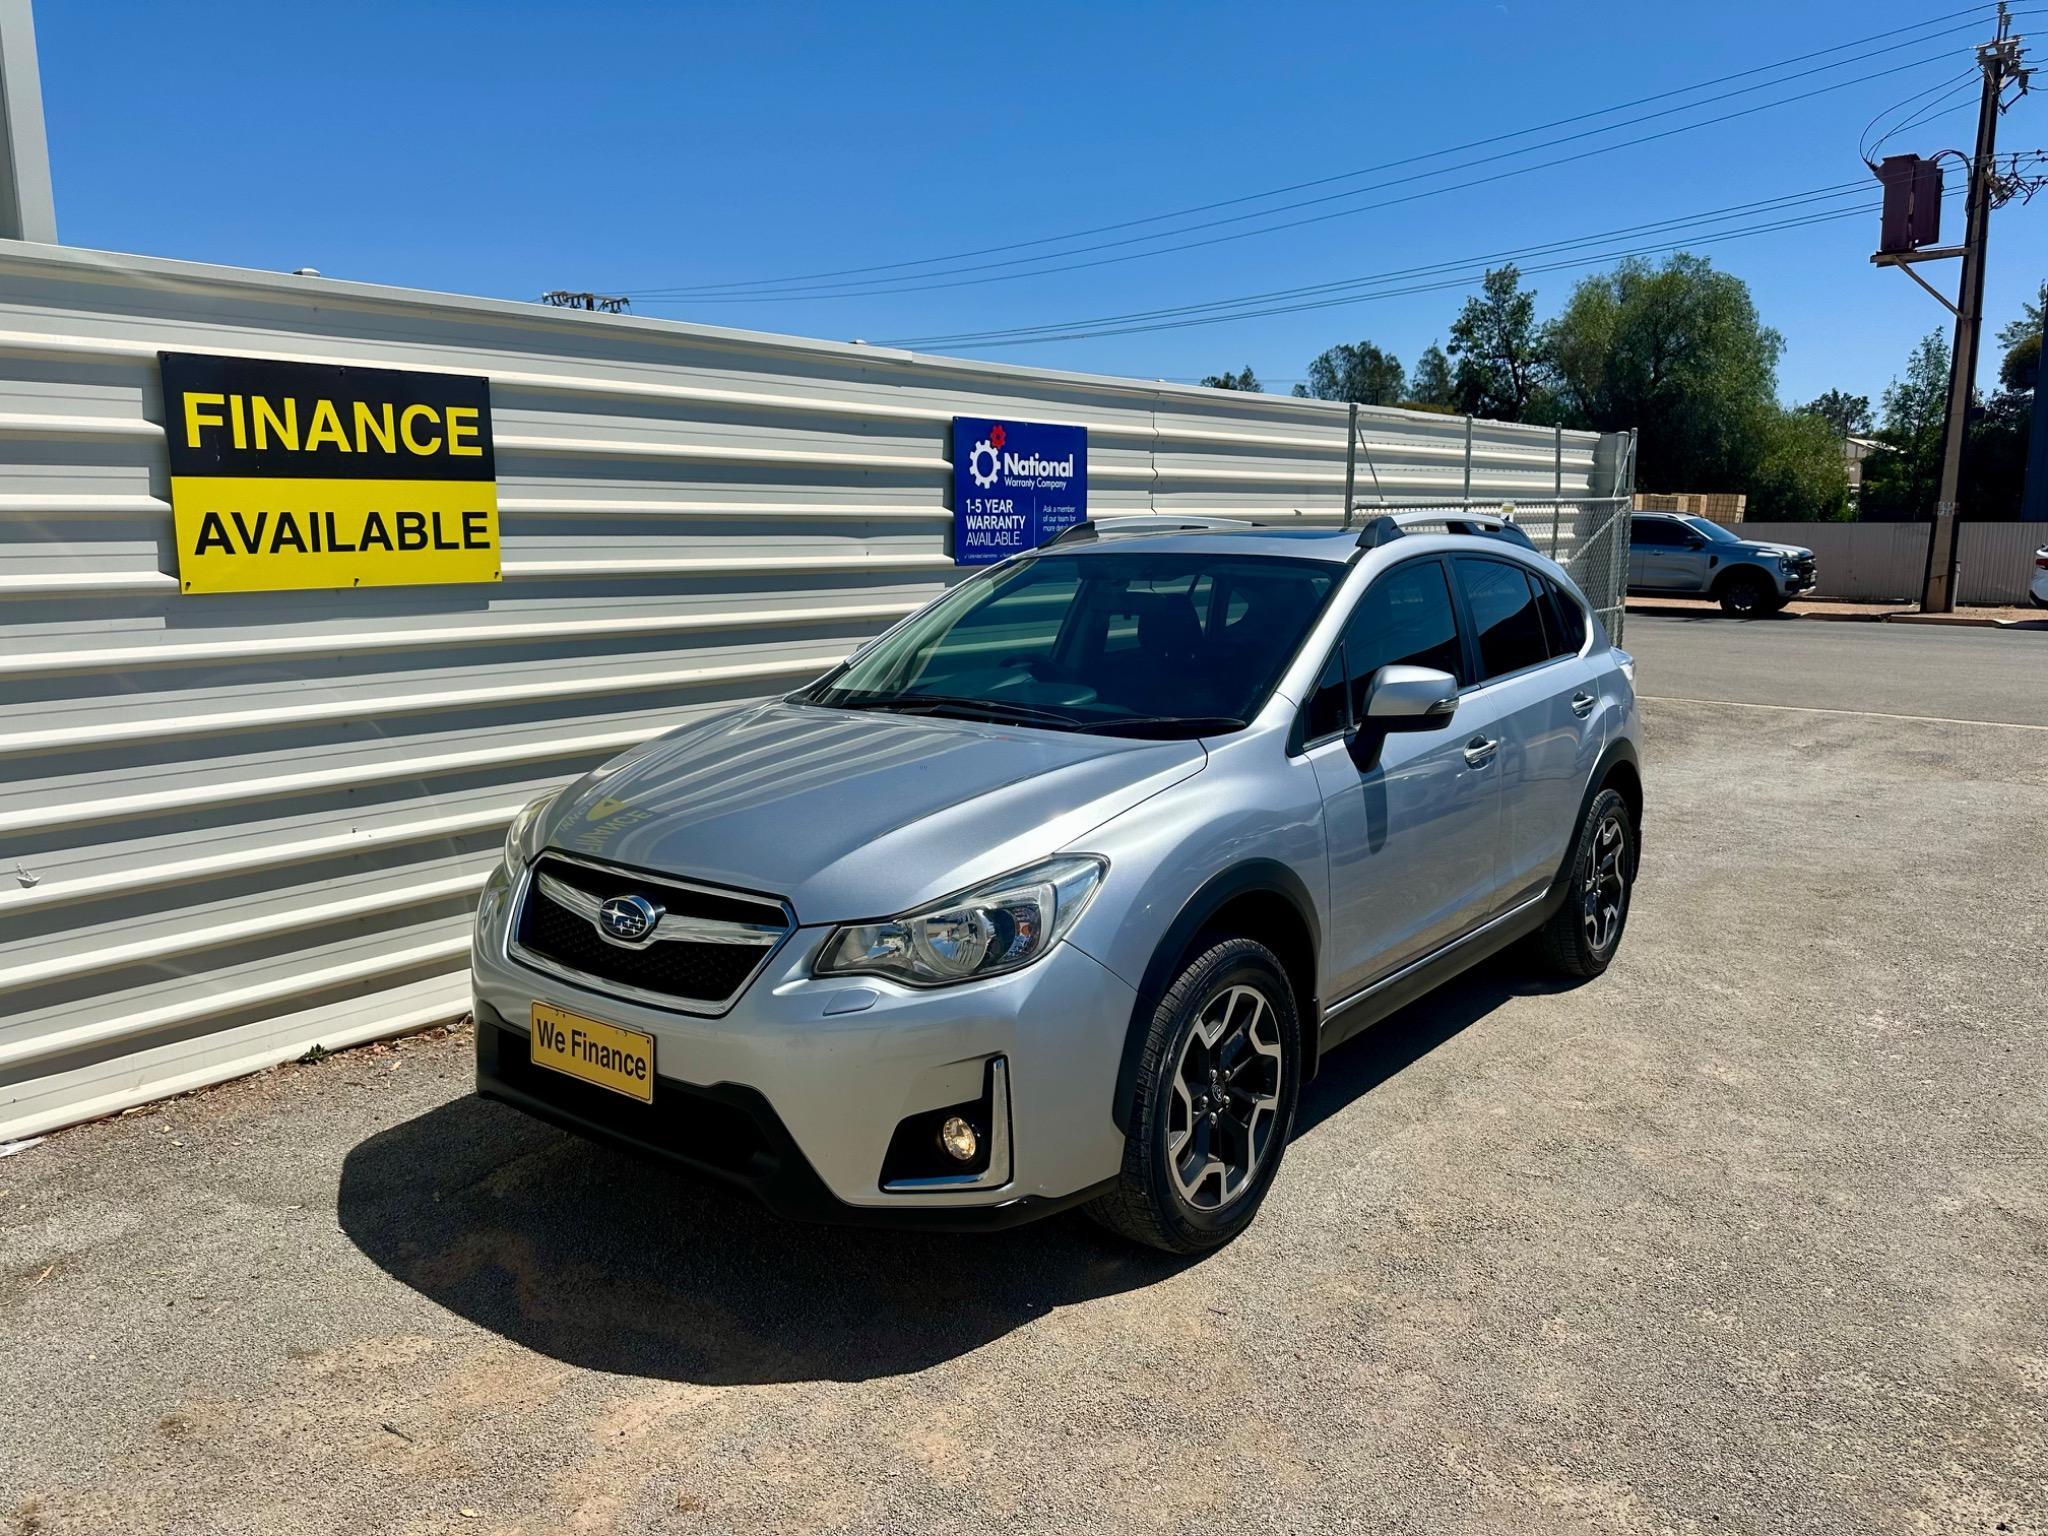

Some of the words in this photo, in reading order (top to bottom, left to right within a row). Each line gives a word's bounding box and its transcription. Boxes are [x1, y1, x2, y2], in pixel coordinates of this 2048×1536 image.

[183, 391, 483, 457] FINANCE
[1004, 452, 1073, 477] National
[1004, 476, 1035, 490] Warranty
[1036, 477, 1067, 490] Company
[966, 499, 982, 513] 1-5
[984, 499, 1013, 513] YEAR
[966, 515, 1026, 530] WARRANTY
[194, 511, 491, 555] AVAILABLE
[966, 531, 1023, 546] AVAILABLE.
[536, 1018, 566, 1053] We
[571, 1028, 647, 1081] Finance
